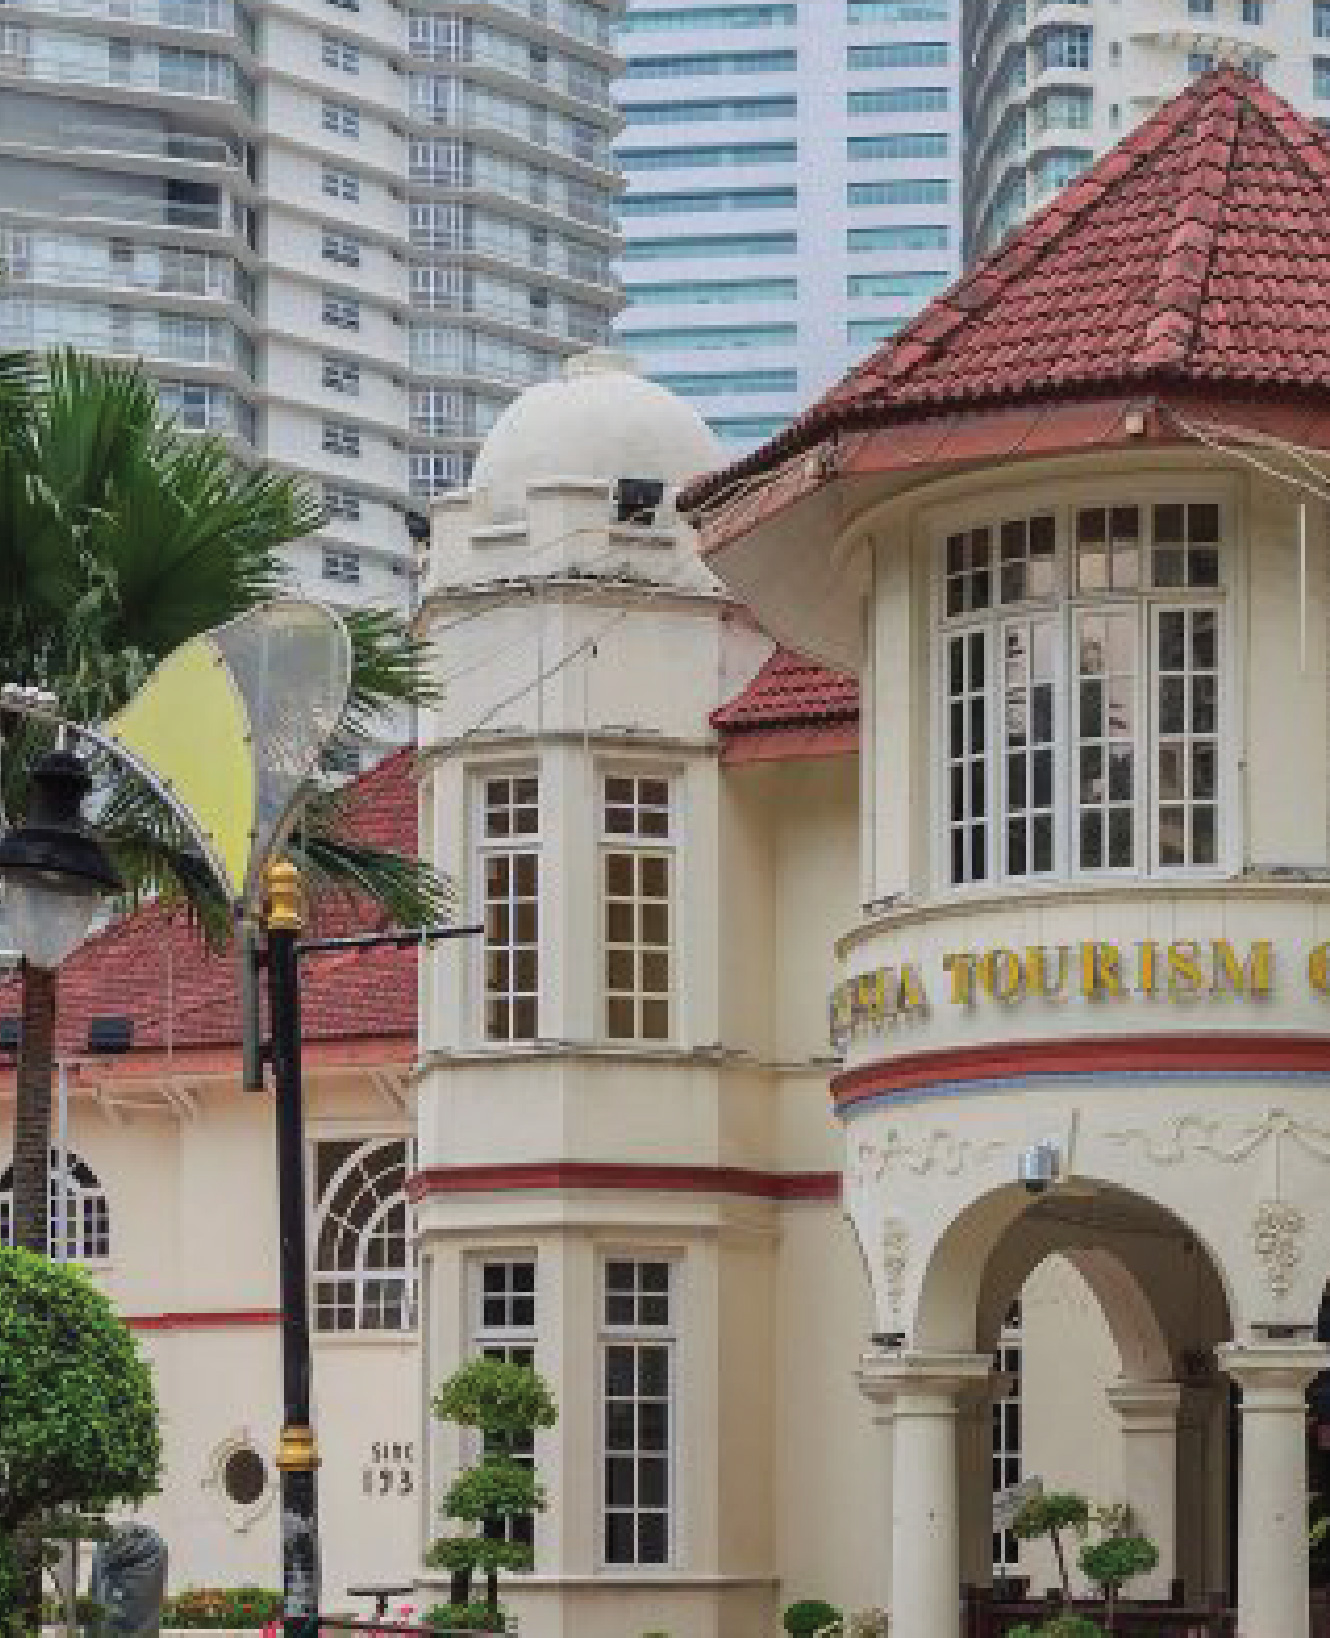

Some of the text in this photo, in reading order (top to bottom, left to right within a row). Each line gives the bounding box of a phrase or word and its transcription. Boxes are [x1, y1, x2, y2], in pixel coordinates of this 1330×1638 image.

[942, 938, 1273, 1006] TOURISM
[371, 1441, 413, 1463] SINC
[362, 1467, 413, 1496] 193
